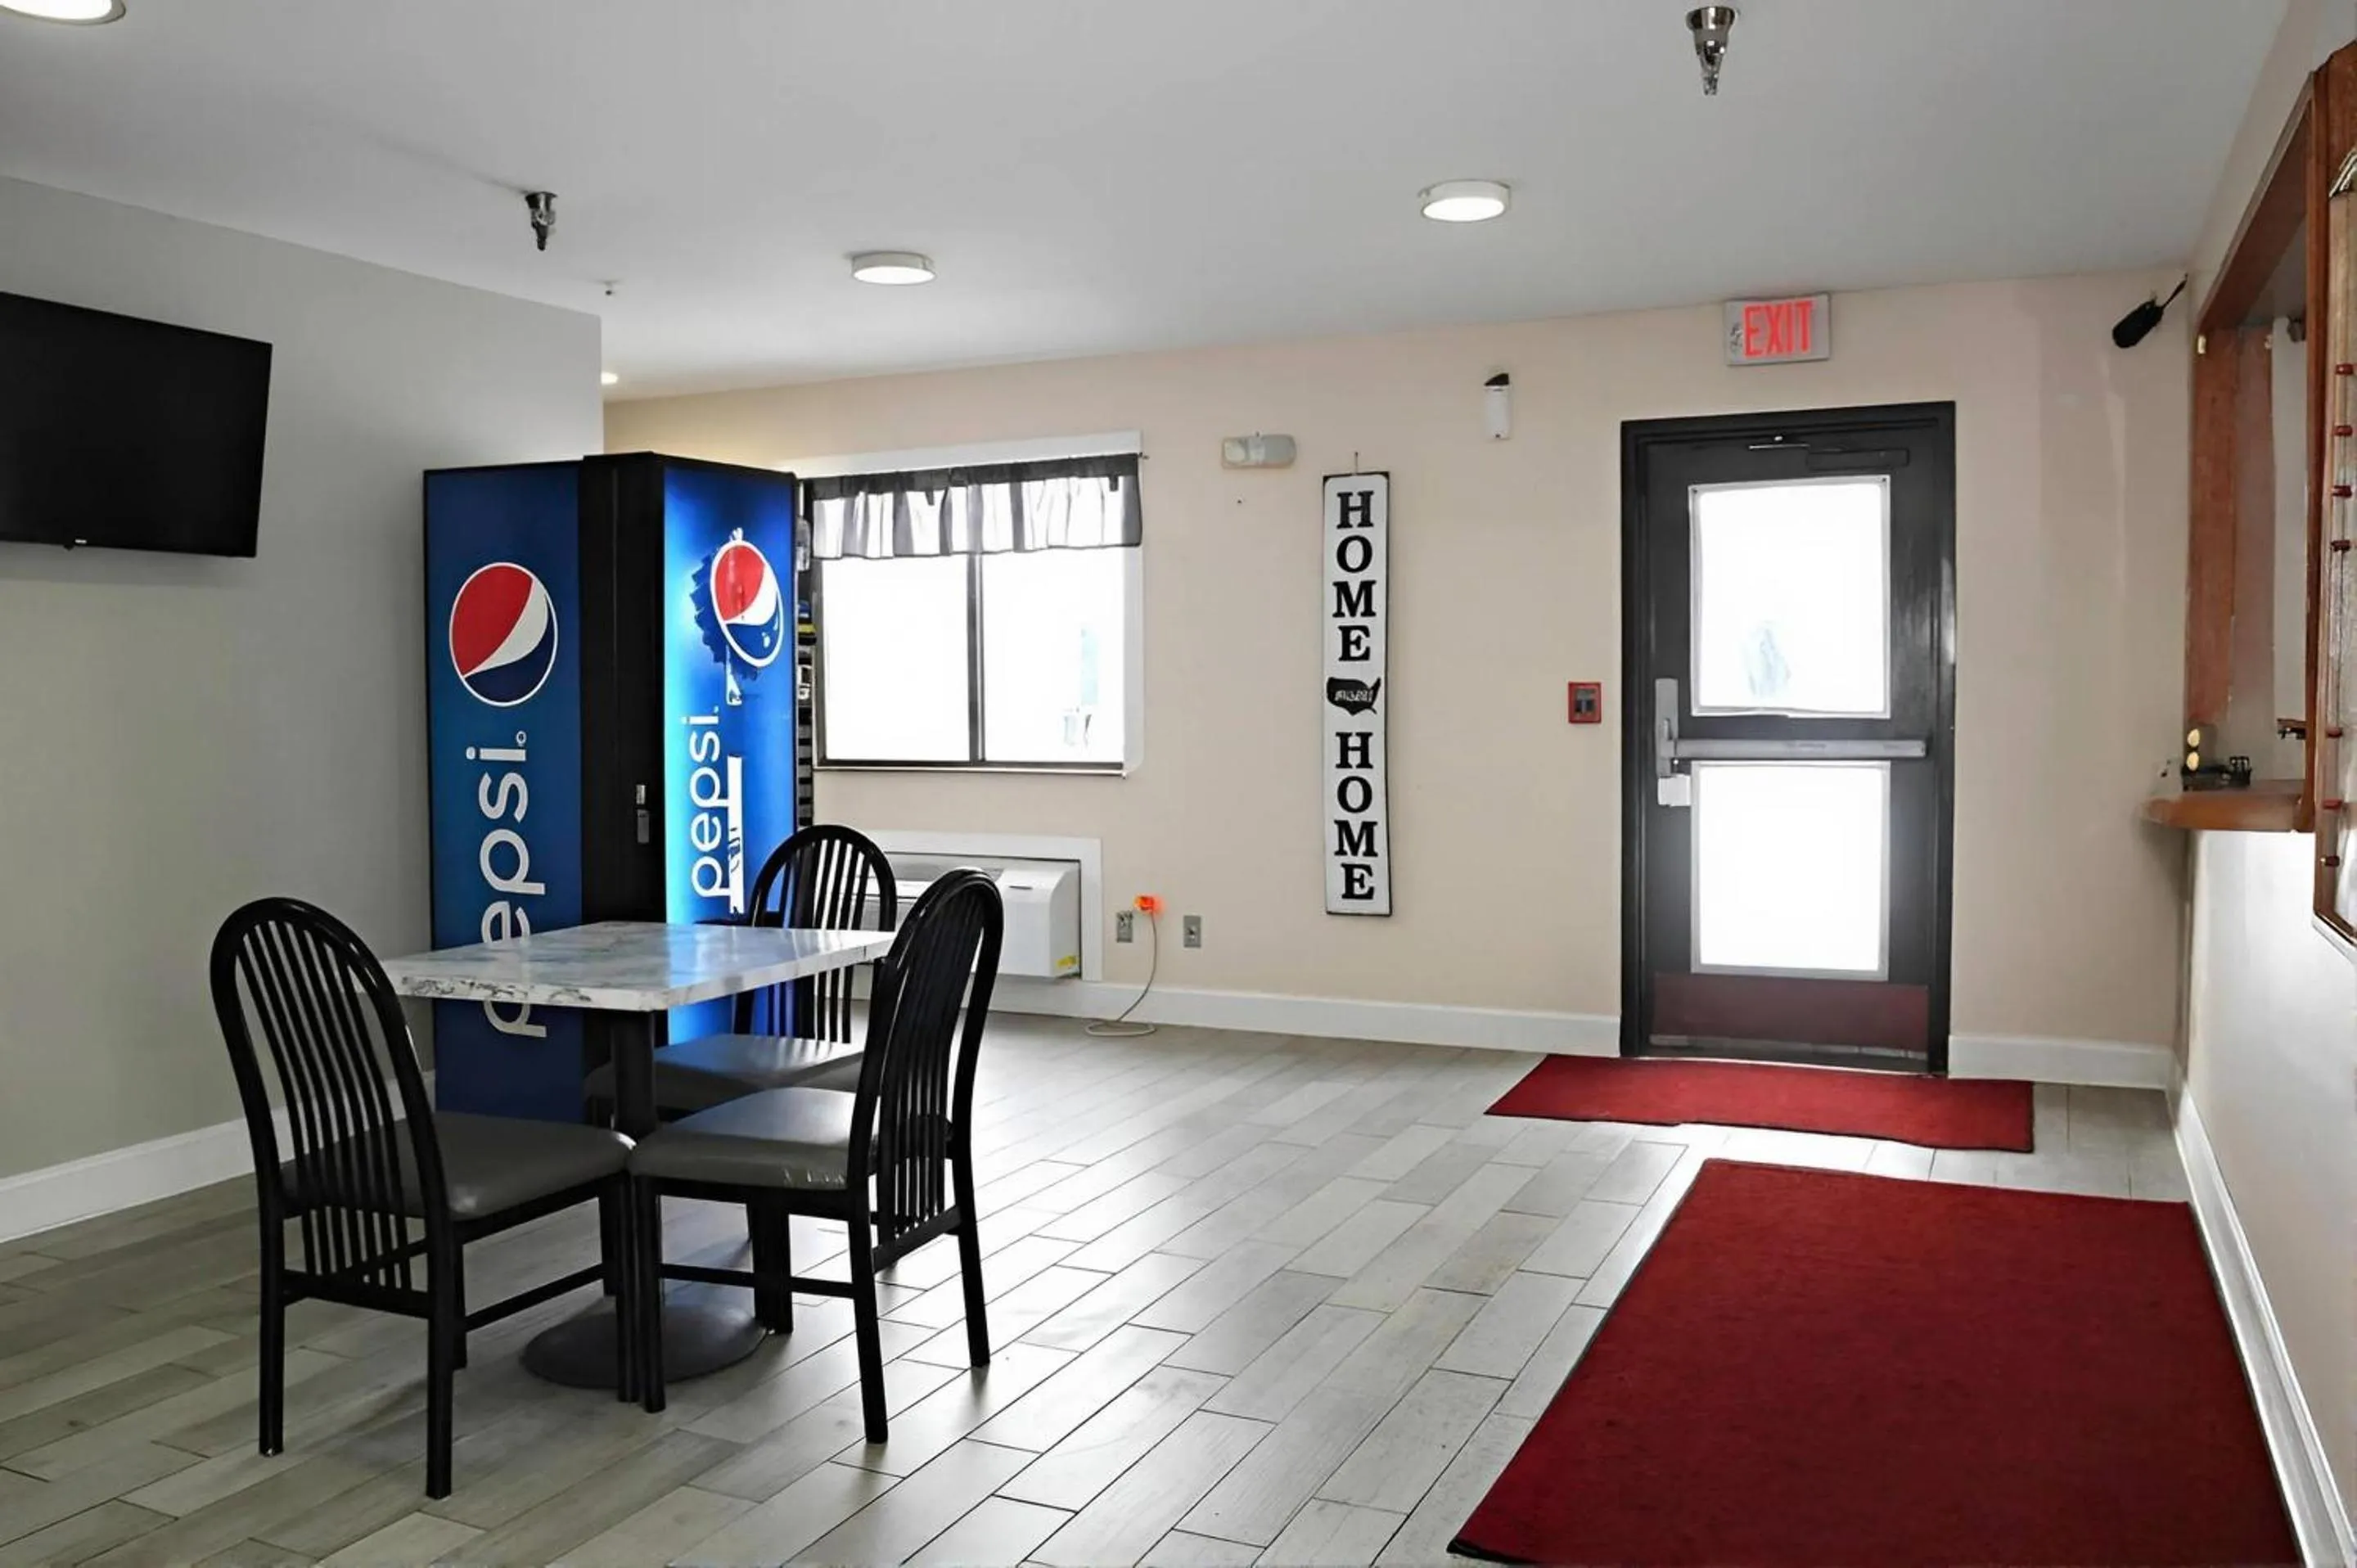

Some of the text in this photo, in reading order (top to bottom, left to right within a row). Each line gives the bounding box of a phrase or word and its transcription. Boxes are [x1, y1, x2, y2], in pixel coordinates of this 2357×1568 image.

[1743, 300, 1814, 357] EXIT
[1332, 491, 1377, 661] HOME
[681, 714, 732, 897] pepsi
[1334, 732, 1378, 900] HOME
